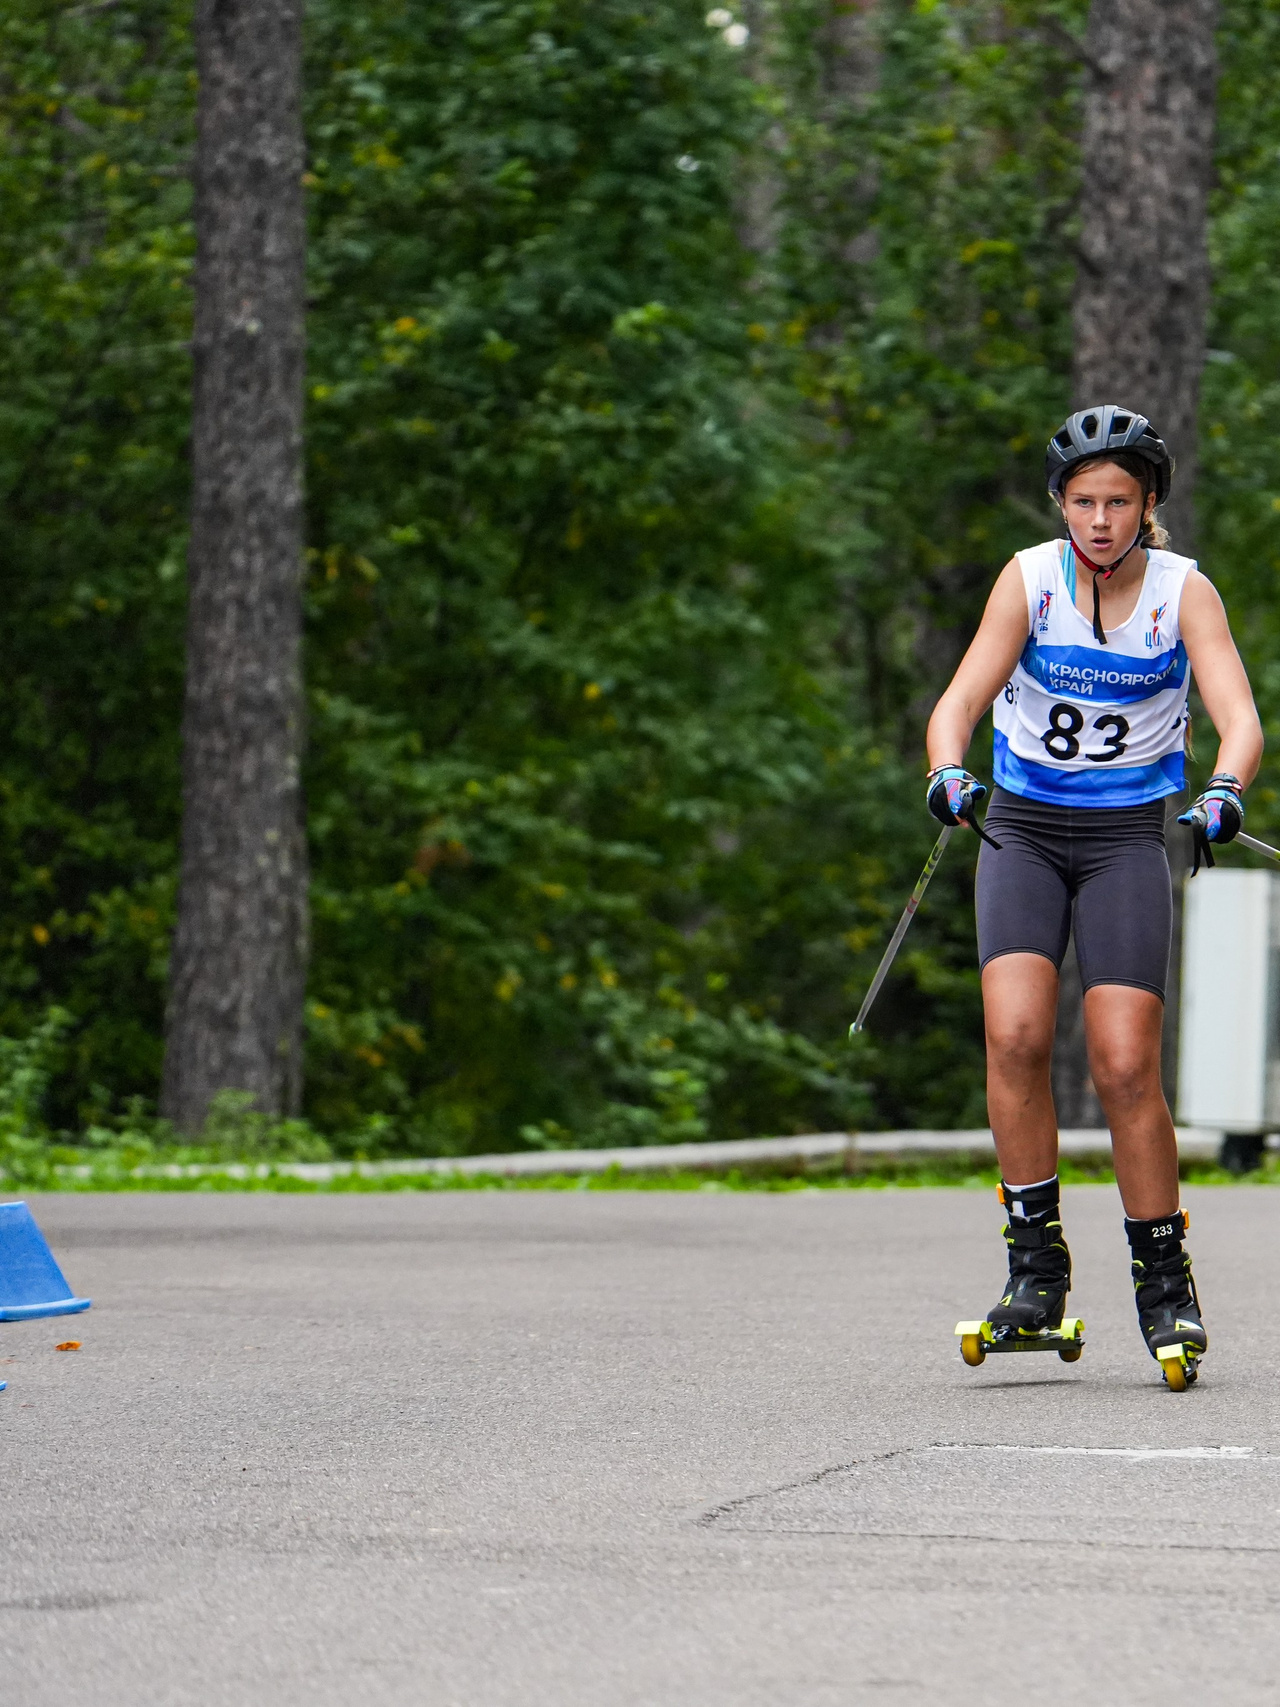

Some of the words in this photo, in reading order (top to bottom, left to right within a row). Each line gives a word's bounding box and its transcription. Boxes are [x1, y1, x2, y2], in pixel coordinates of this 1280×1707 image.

[1049, 677, 1094, 695] КРАЙ
[1040, 703, 1130, 762] 83
[1151, 1223, 1173, 1238] 233
